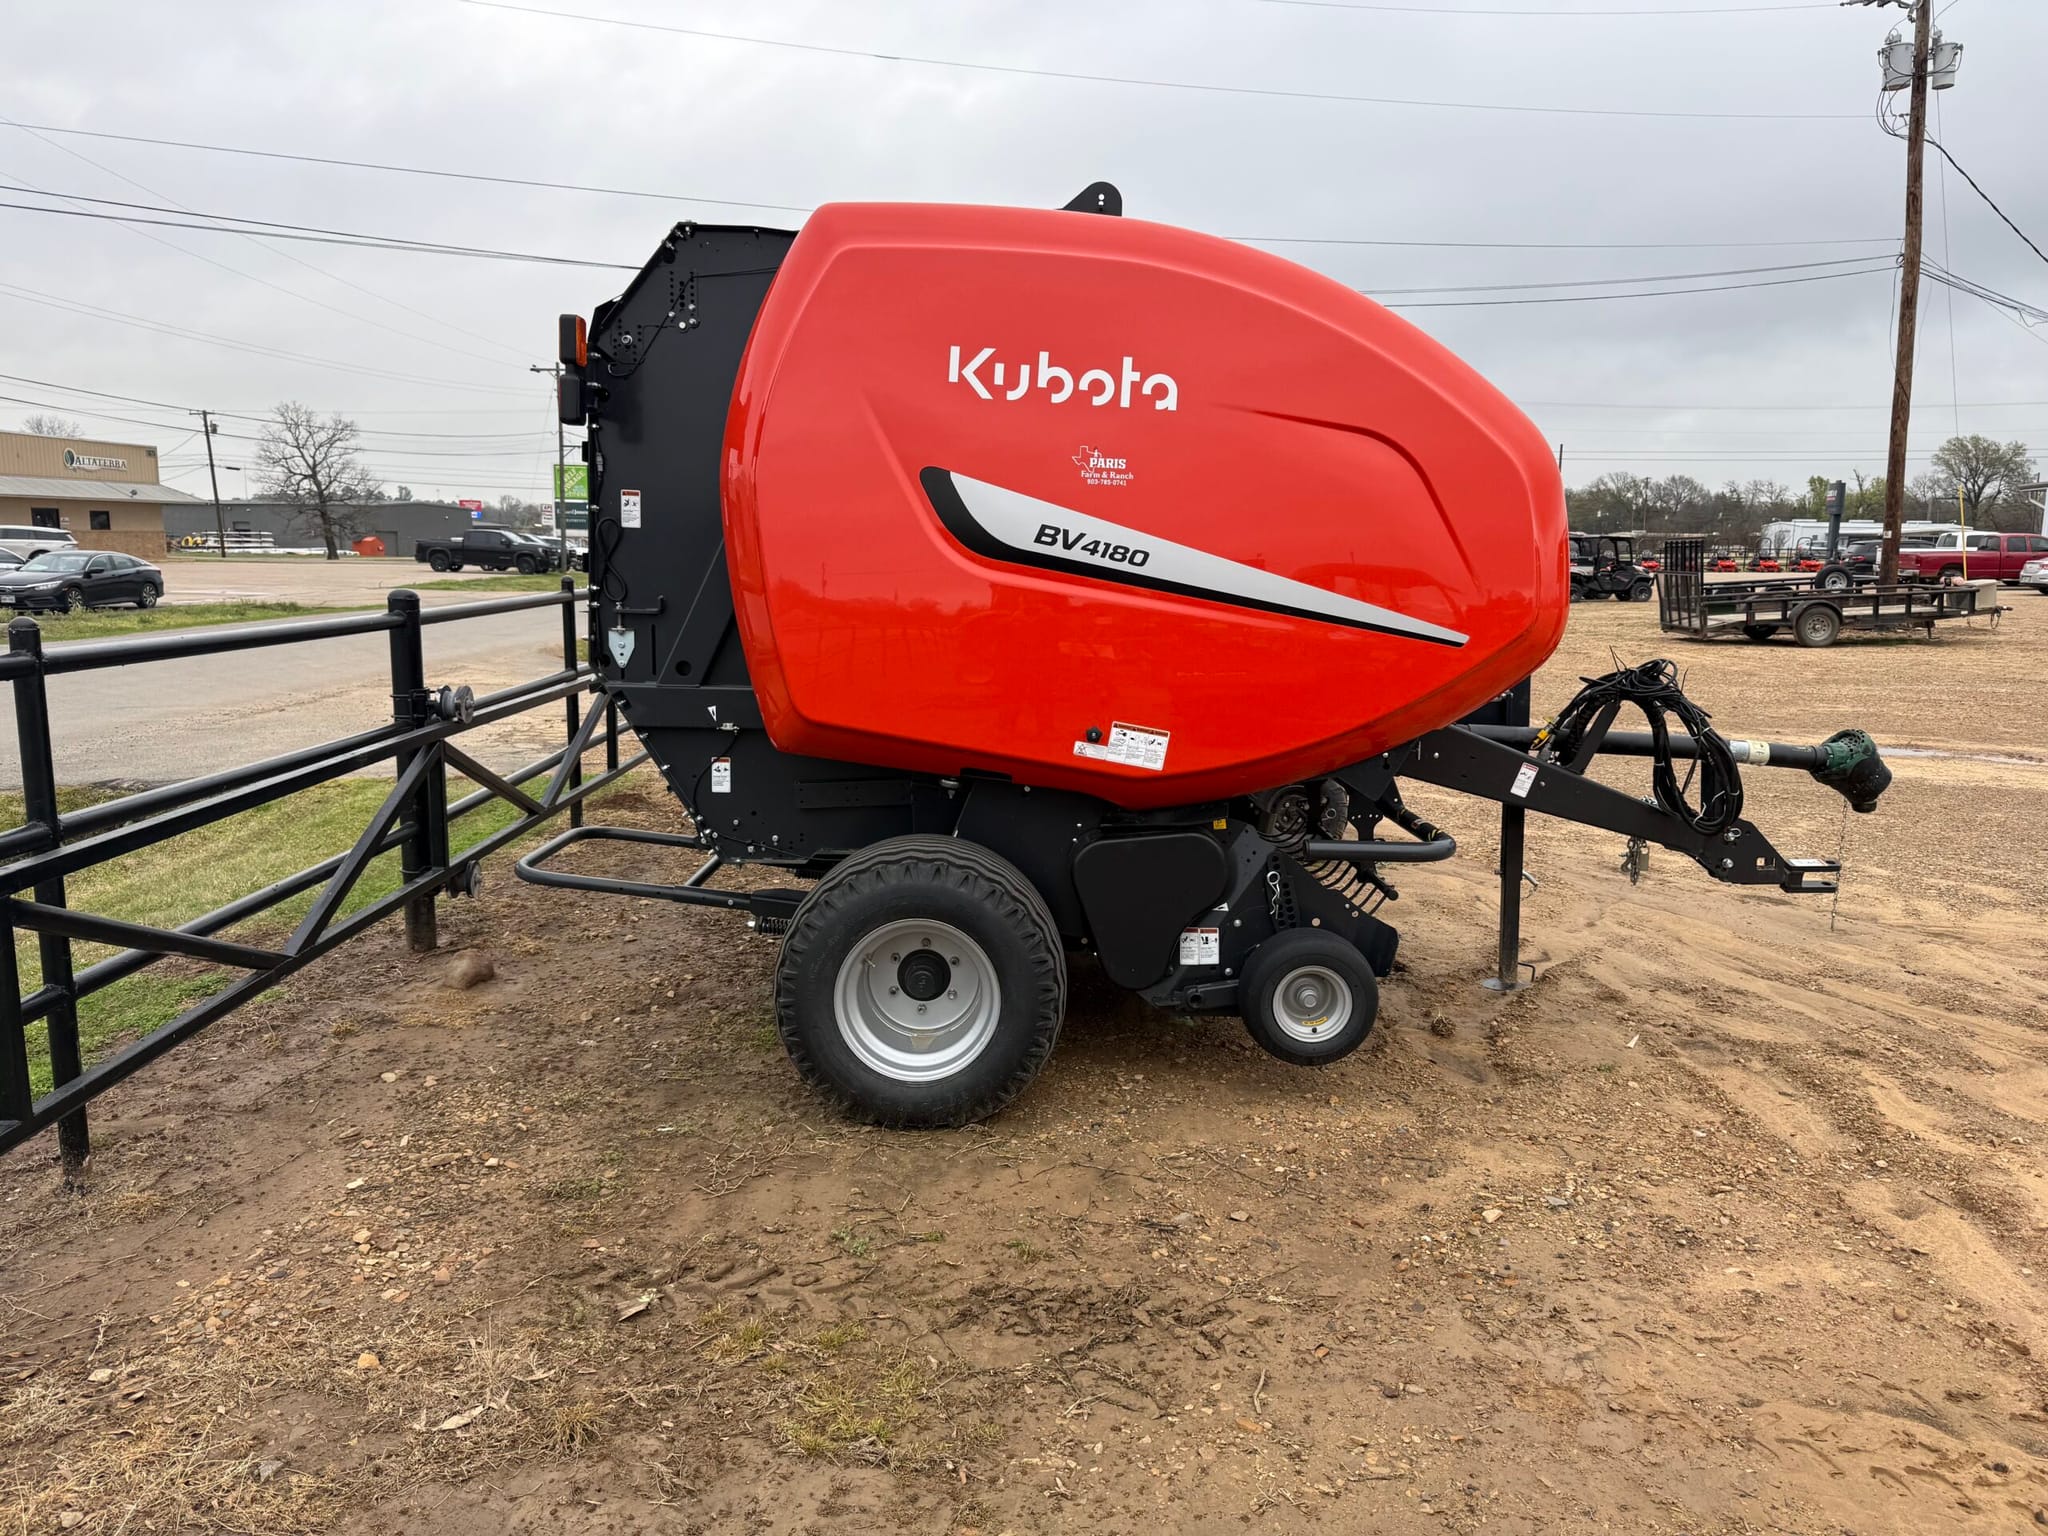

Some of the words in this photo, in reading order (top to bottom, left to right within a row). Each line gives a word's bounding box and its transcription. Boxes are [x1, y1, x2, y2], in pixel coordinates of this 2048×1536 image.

[949, 345, 1178, 411] Kubota
[75, 457, 126, 469] ALTATERRA
[1089, 457, 1127, 469] PARIS
[1081, 470, 1100, 479] Farm
[1101, 471, 1108, 479] &
[1110, 471, 1134, 480] Ranch
[1033, 523, 1150, 567] BV4180
